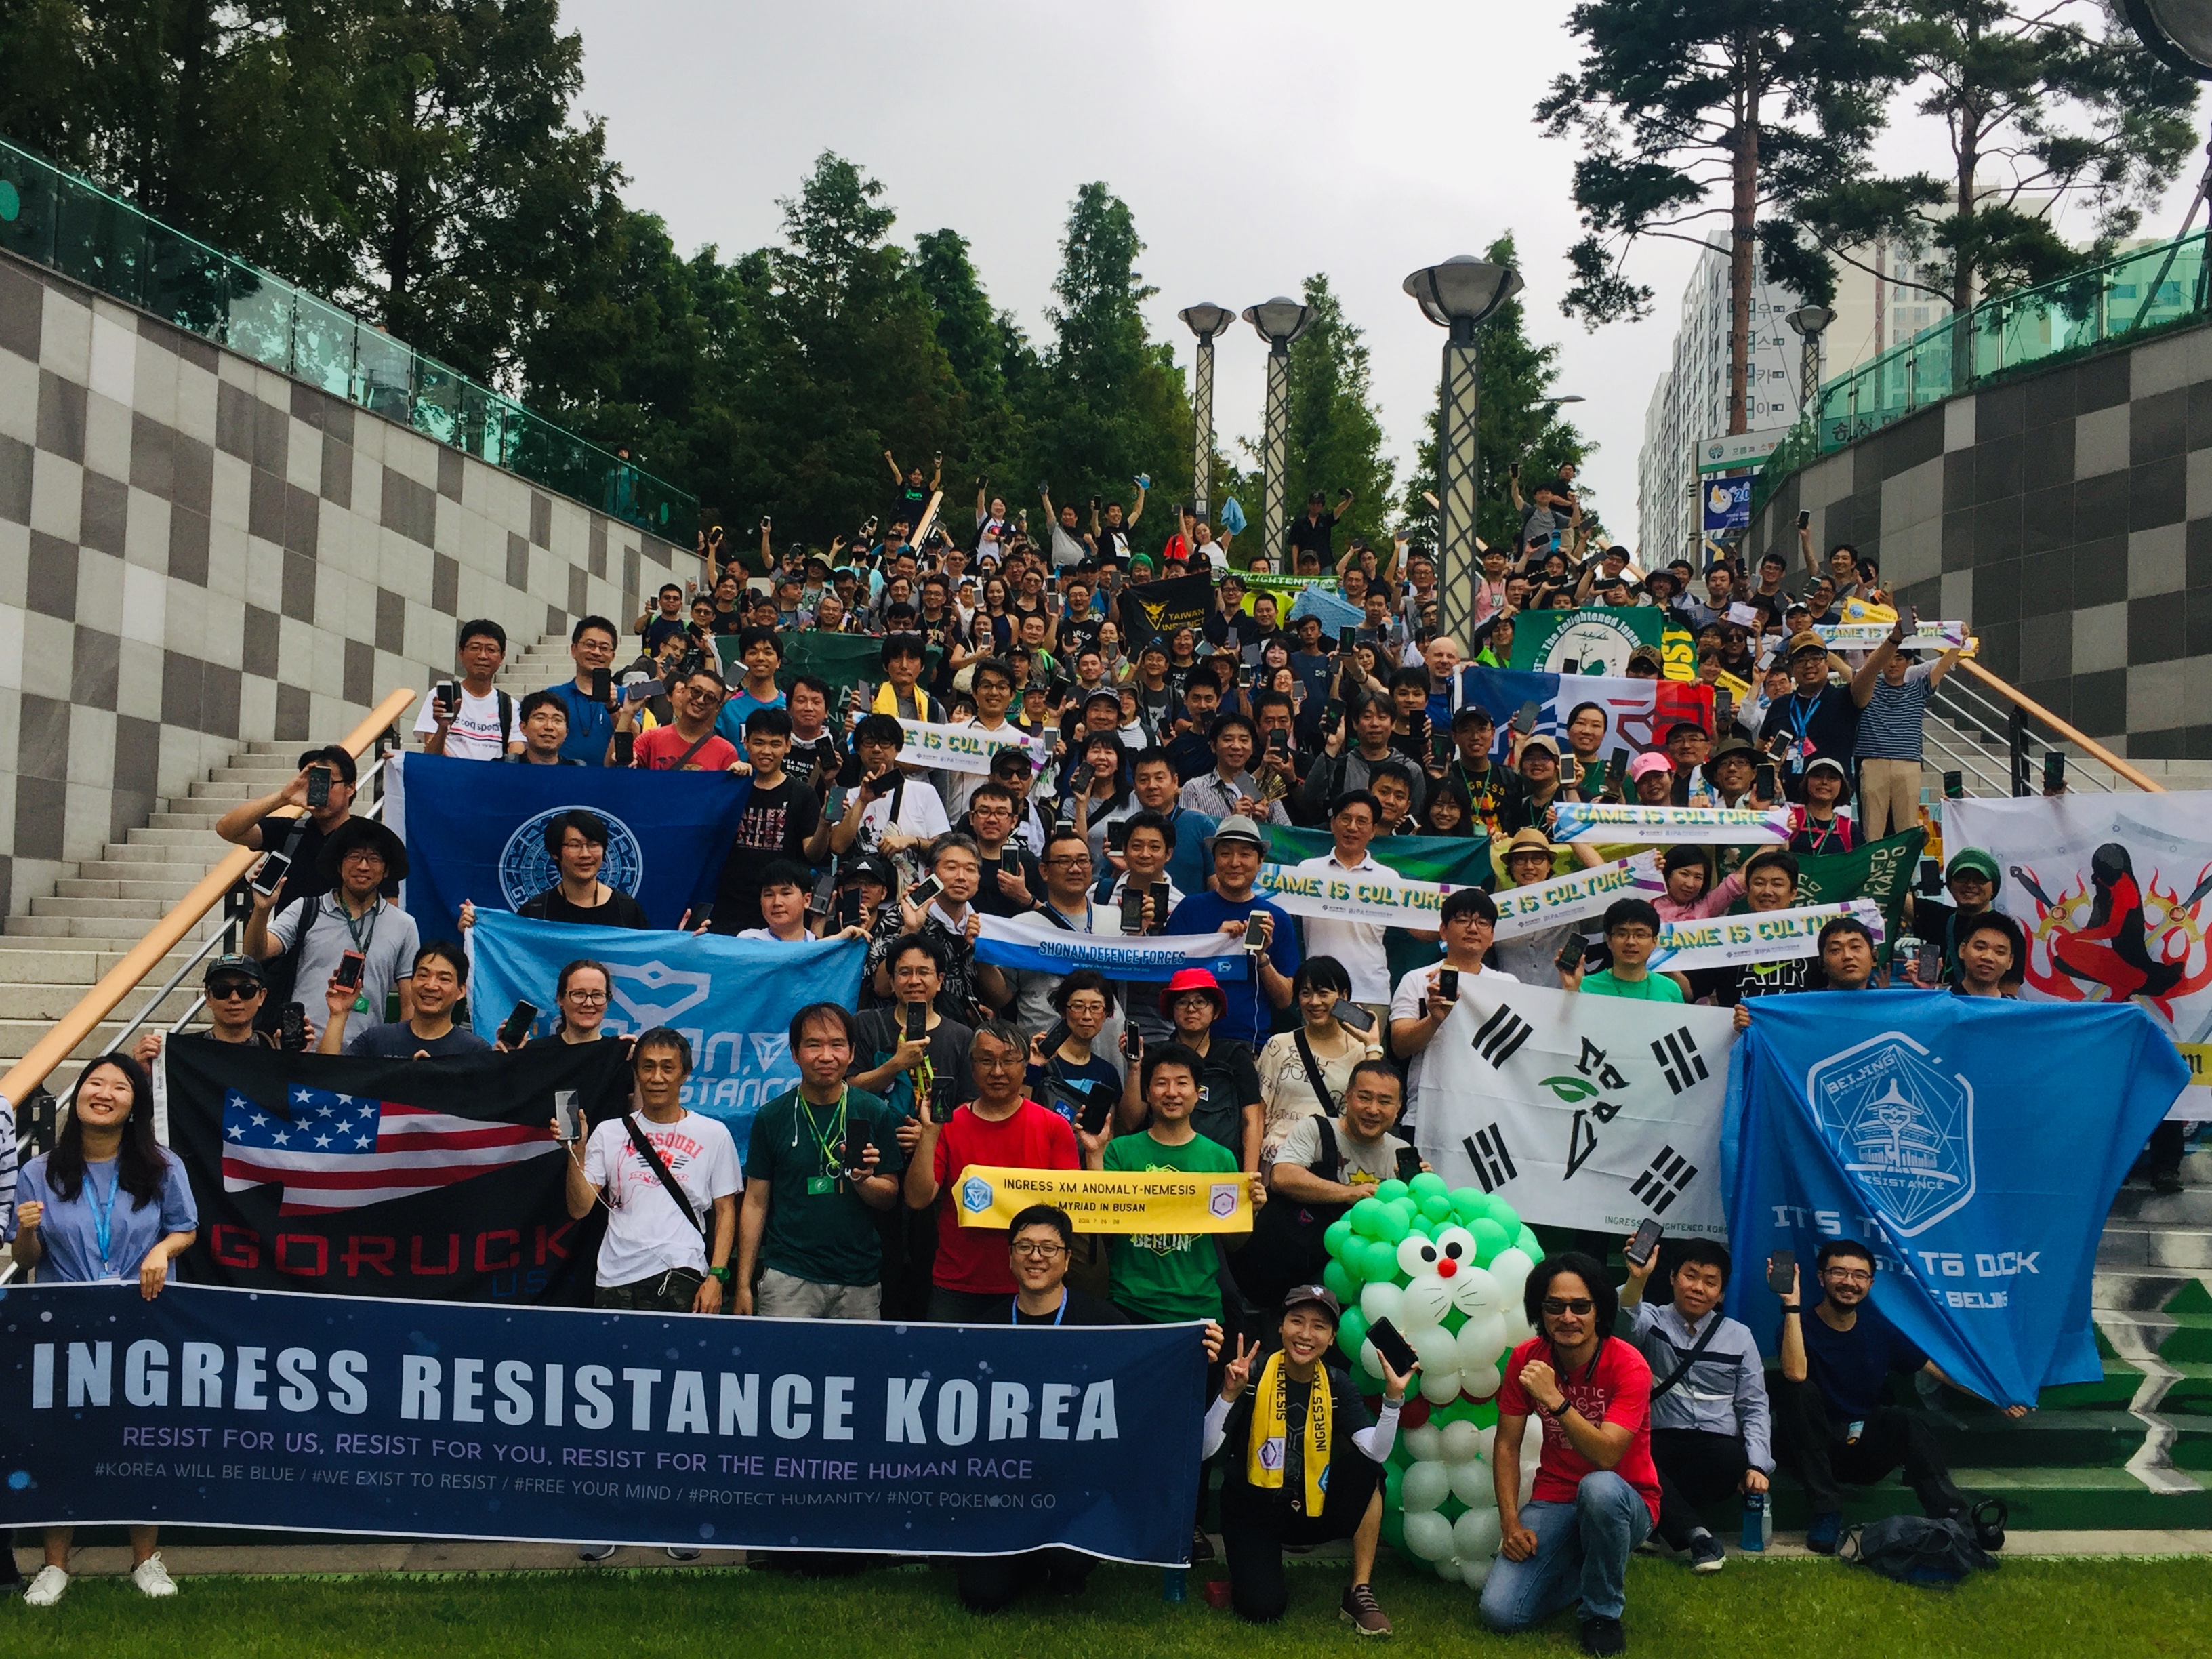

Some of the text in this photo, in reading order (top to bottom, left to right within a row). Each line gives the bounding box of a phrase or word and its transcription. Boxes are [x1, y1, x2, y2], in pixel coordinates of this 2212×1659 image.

[1168, 608, 1205, 621] TAIWAN
[1541, 611, 1641, 651] The Enlightened Japan
[1824, 626, 1948, 639] GAME IS CURE
[922, 730, 943, 750] IS
[1573, 806, 1769, 825] GAME IS CULTURE
[1258, 871, 1451, 912] GAME IS CULTURE
[1516, 893, 1540, 914] IS
[1542, 865, 1636, 906] CULTURE
[1657, 926, 1723, 951] GAME
[1725, 924, 1752, 944] IS
[1038, 941, 1187, 966] SHONAN DEFENCE FORCES
[1736, 957, 1809, 988] AIR
[1826, 1053, 1898, 1095] BEIJING
[623, 1132, 705, 1160] MSSOURI
[1004, 1178, 1197, 1196] INGRESS XM ANOMALY-NEMESIS
[1858, 1174, 1946, 1191] RESISTANCE
[1058, 1202, 1146, 1213] MYRIAD IN BUSAN
[1605, 1215, 1728, 1235] INGRESS IGHTENED KORE
[211, 1220, 580, 1277] GORUCK
[1133, 1233, 1189, 1252] BERLIN
[32, 1338, 1120, 1446] INGRESS RESISTANCE KOREA
[1558, 1383, 1605, 1399] ANTIC
[1313, 1396, 1327, 1452] INGRESS
[123, 1426, 1033, 1481] RESIST FOR US, RESIST FOR YOU, RESIST FOR THE ENTIRE HUMAN RACE
[94, 1461, 169, 1479] #KOREA
[174, 1463, 216, 1479] WILL
[223, 1465, 245, 1480] BE
[250, 1465, 294, 1482] BLUE
[312, 1468, 350, 1486] #WE
[356, 1470, 404, 1488] EXIST
[409, 1471, 435, 1488] TO
[440, 1473, 498, 1491] RESIST
[514, 1476, 566, 1494] #FREE
[571, 1478, 619, 1496] YOUR
[626, 1483, 672, 1501] MIND
[688, 1488, 775, 1507] #PROTECT
[886, 1489, 935, 1507] #NOT
[939, 1491, 1025, 1510] POKEMON
[1031, 1492, 1057, 1510] GO
